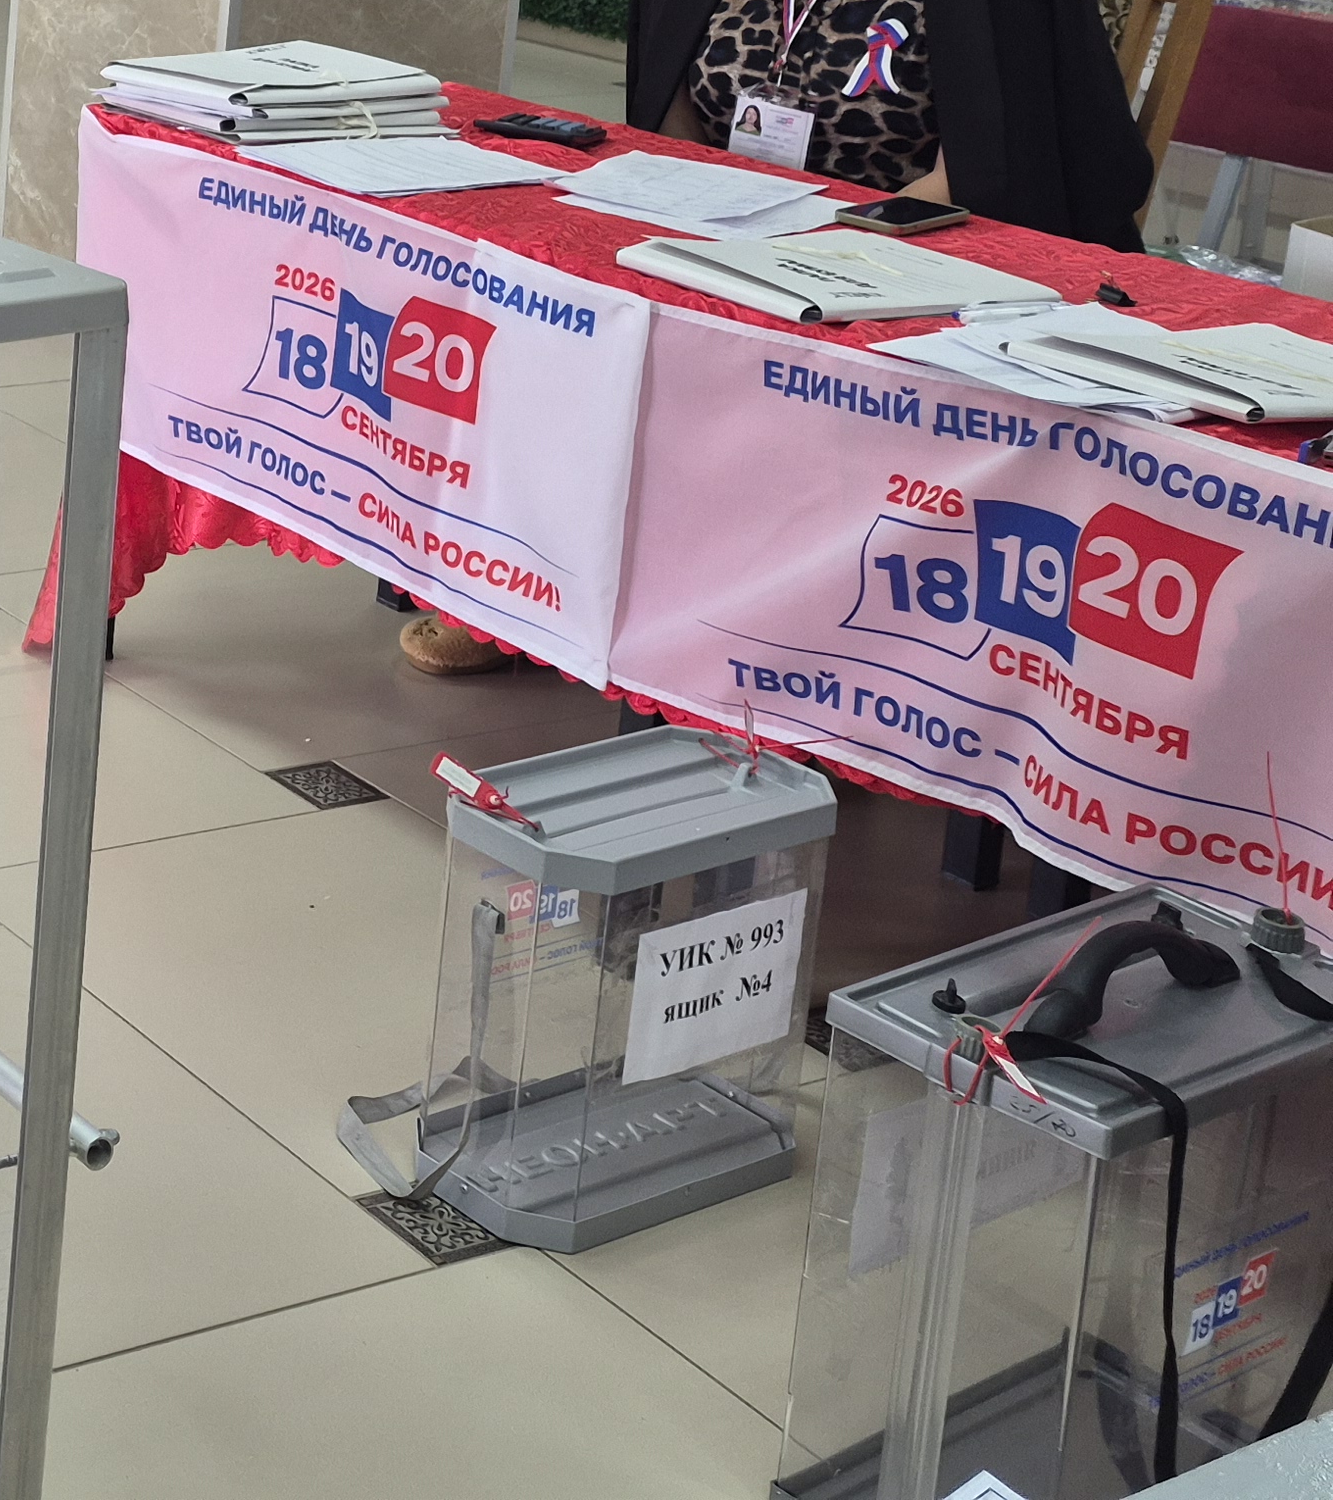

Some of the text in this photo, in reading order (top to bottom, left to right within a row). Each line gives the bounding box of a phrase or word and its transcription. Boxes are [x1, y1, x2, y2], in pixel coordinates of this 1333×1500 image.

[198, 177, 596, 337] ЕДИНЫЙ ДЕНЬ ГОЛОСОВАНИЯ
[274, 264, 334, 301] 2026
[275, 321, 475, 393] 18 19 20
[341, 405, 471, 489] СЕНТЯБРЯ
[763, 359, 1333, 549] ЕДИНЫЙ ДЕНЬ ГОЛОСОВАН
[167, 414, 242, 458] ТВОЙ
[247, 441, 326, 496] ГОЛОС
[358, 492, 417, 549] СИЛА
[424, 530, 562, 612] РОССИИ!
[886, 473, 966, 518] 2026
[874, 533, 1199, 637] 18 19 20
[989, 643, 1190, 761] СЕНТЯБРЯ
[727, 657, 841, 710] ТВОЙ
[853, 686, 983, 759] ГОЛОС
[1024, 754, 1111, 835] СИЛА
[660, 919, 785, 977] УИК № 993
[664, 969, 773, 1024] ящик №4
[1192, 1263, 1268, 1342] 18 19 20
